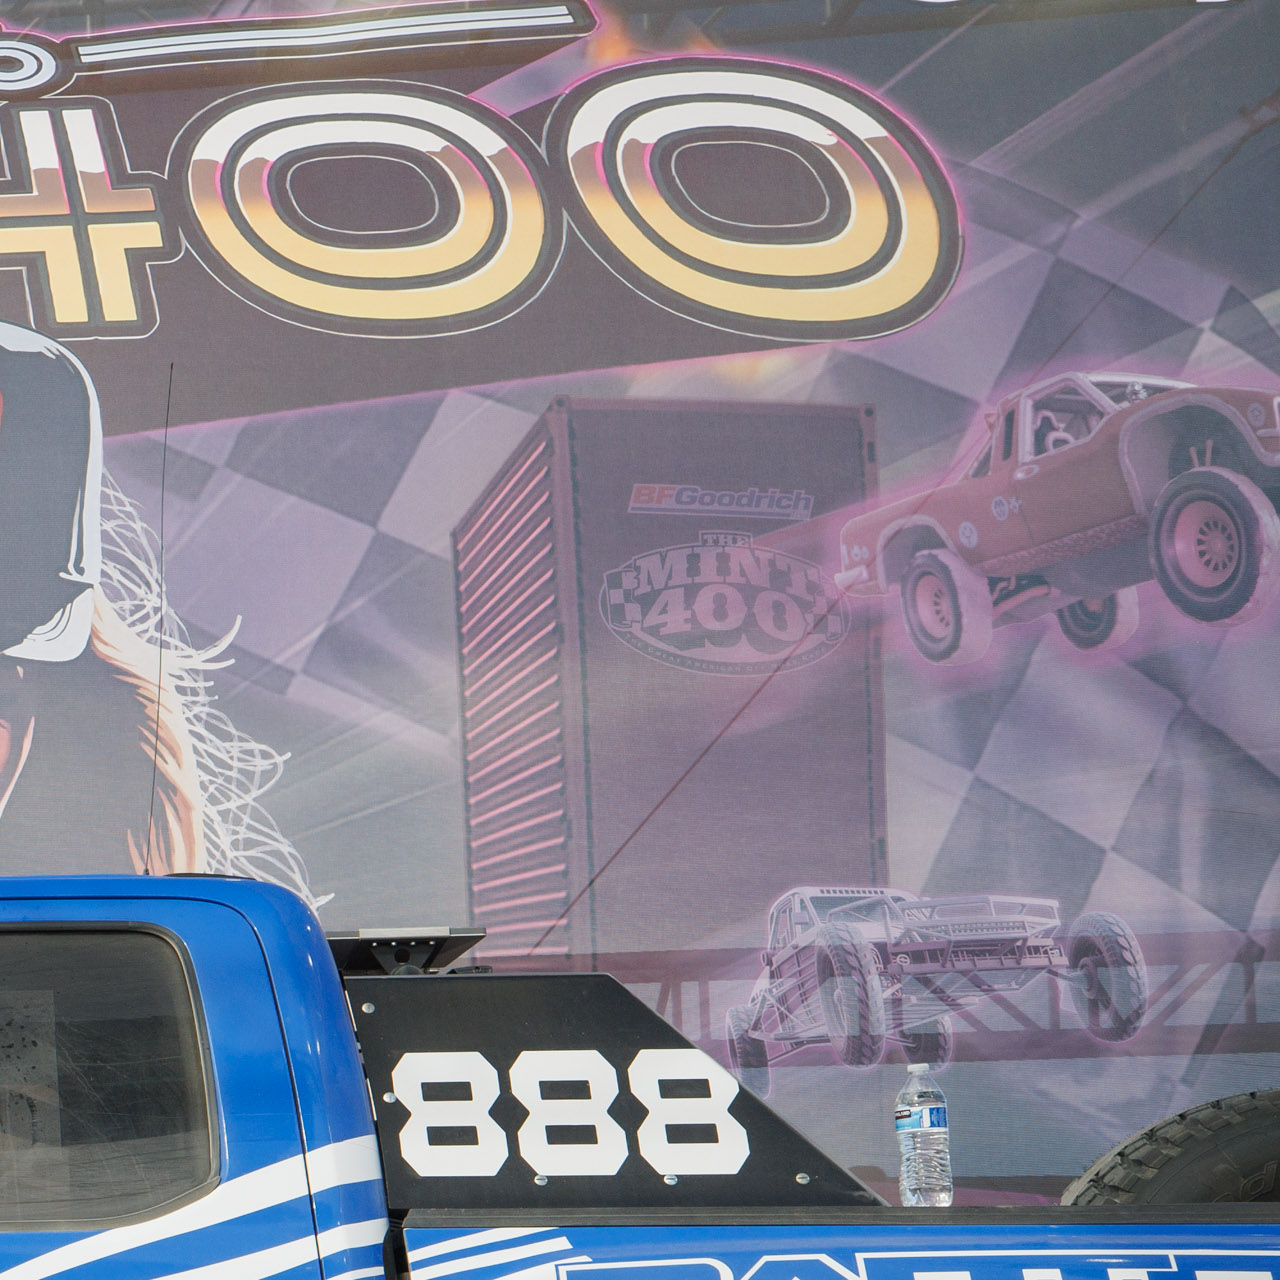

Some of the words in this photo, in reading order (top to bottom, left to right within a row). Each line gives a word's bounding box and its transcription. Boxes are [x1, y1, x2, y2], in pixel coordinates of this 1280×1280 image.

[631, 486, 813, 511] BFGoodrich
[703, 534, 750, 546] THE
[633, 547, 821, 601] MINT
[643, 584, 807, 642] 400
[391, 1048, 750, 1178] 888
